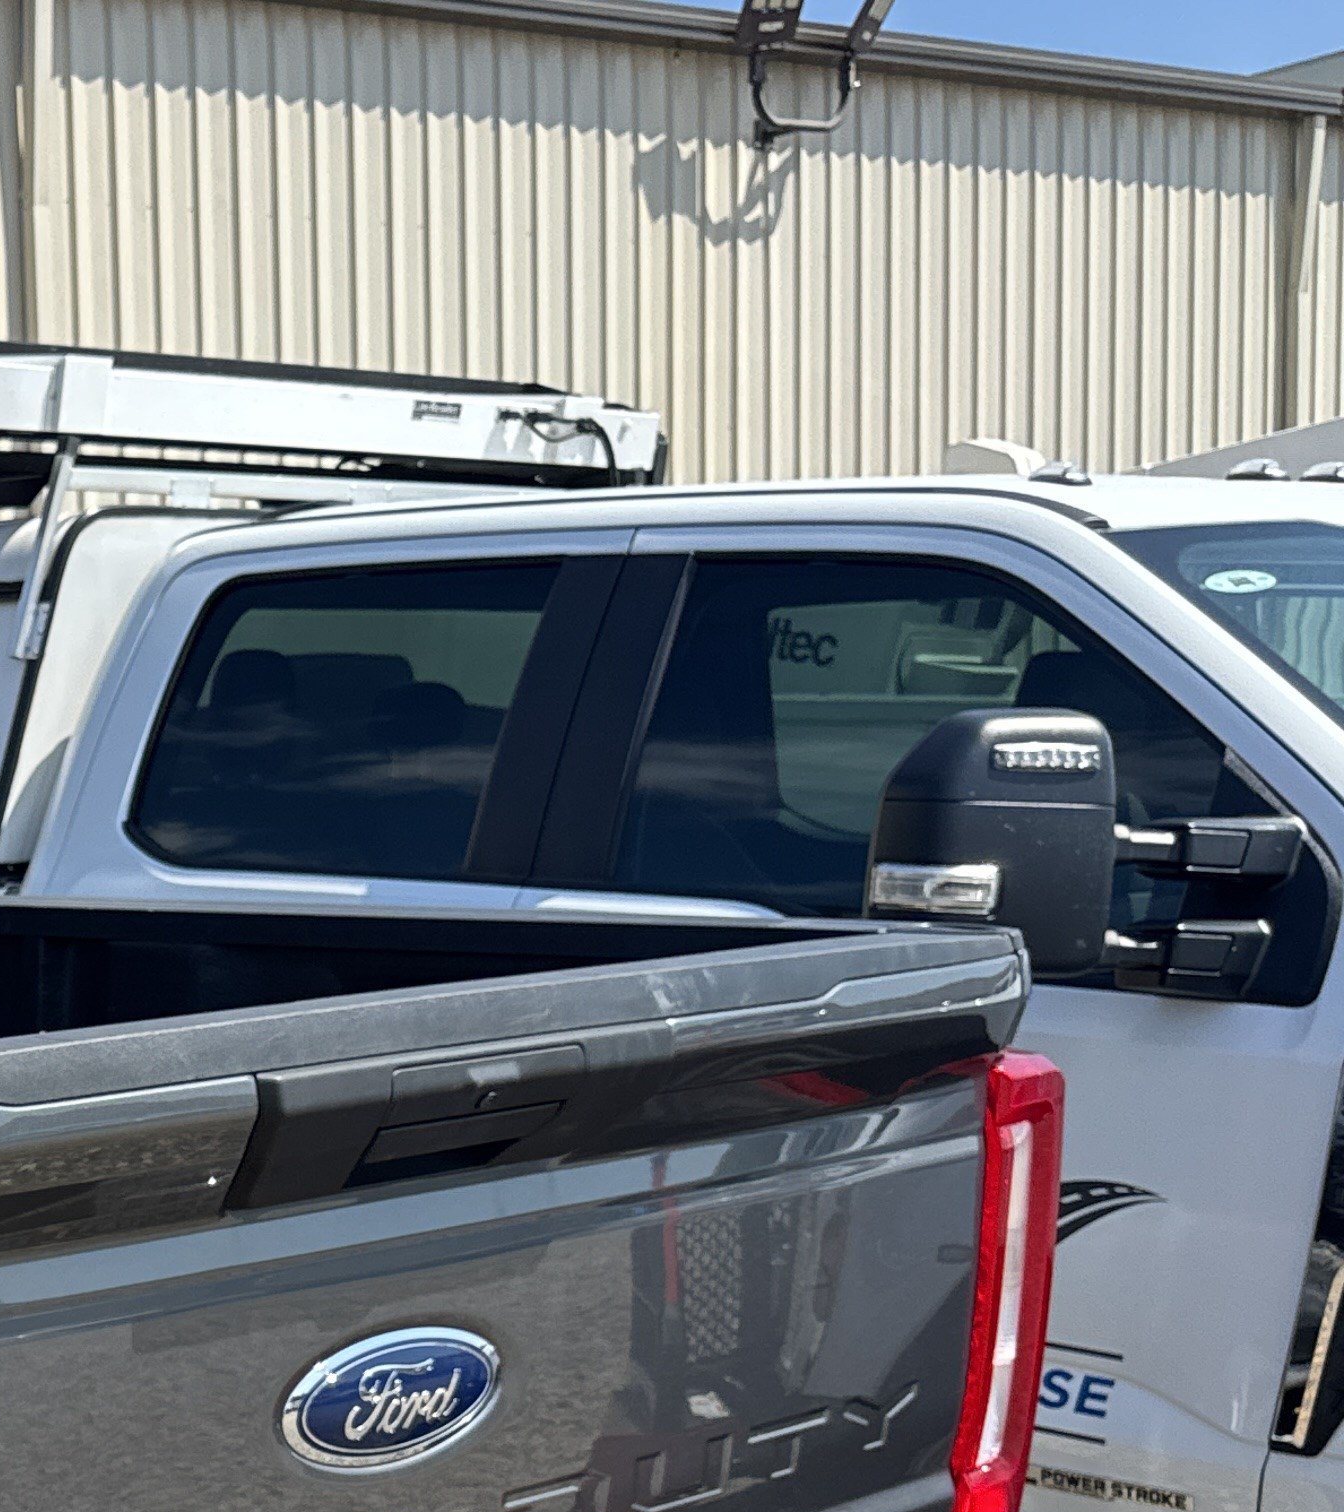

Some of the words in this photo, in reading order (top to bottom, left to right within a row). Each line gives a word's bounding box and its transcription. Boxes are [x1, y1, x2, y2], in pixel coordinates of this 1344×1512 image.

[344, 1358, 461, 1441] Ford
[1041, 1468, 1106, 1498] POWER
[1110, 1481, 1188, 1510] STROKE
